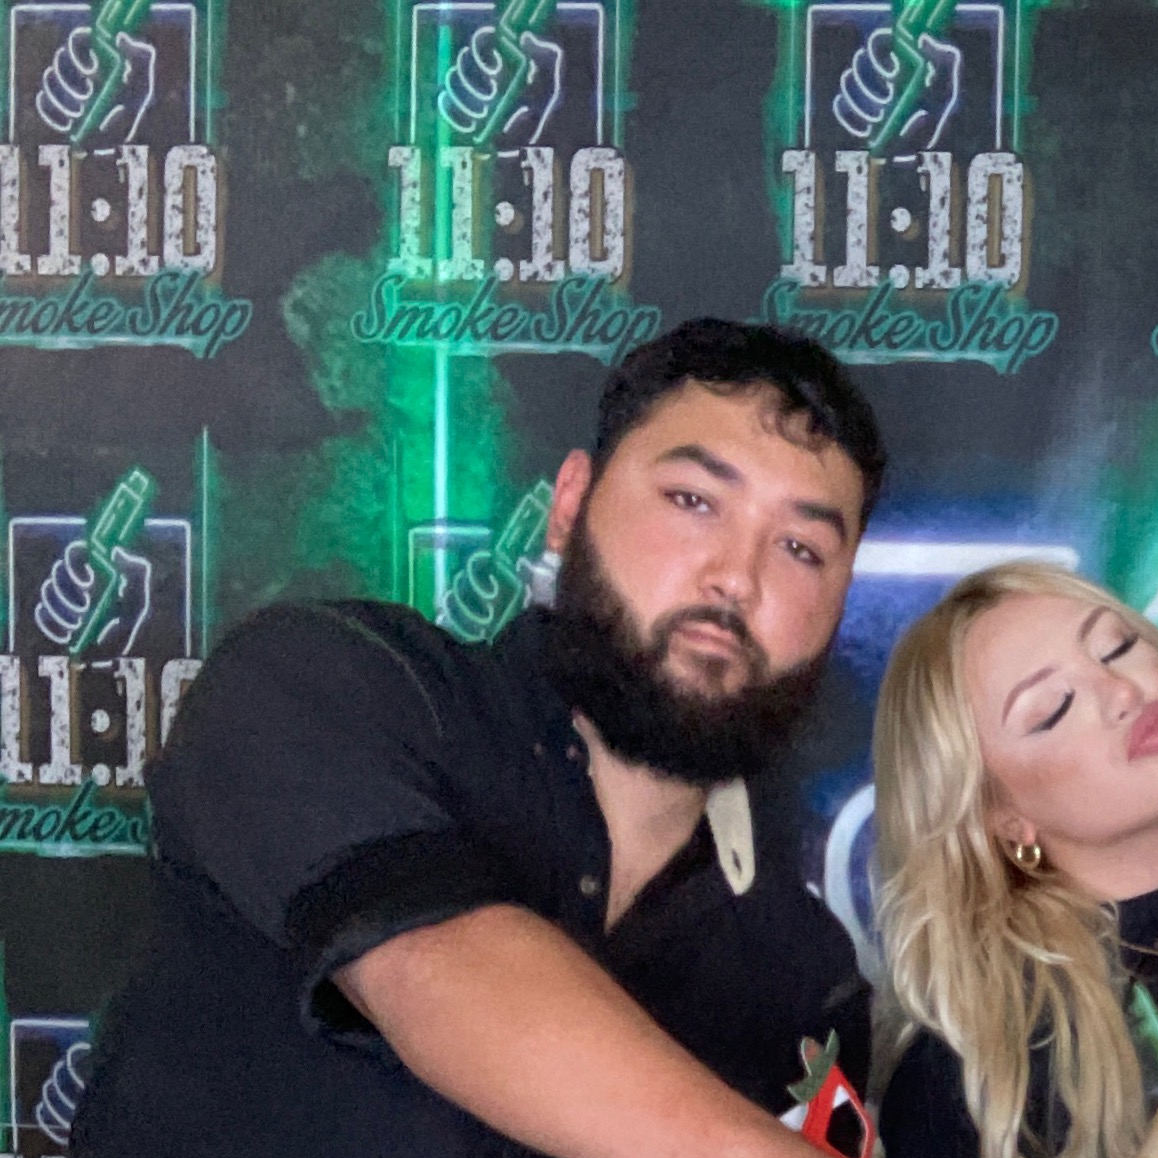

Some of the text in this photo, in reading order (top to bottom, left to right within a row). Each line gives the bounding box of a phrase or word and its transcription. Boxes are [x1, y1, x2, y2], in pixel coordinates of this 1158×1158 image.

[386, 146, 625, 282] 11:10
[780, 151, 1024, 289] 11:10
[0, 268, 252, 359] moke Shop
[351, 271, 662, 367] Smoke Shop
[927, 279, 1060, 374] Shop
[0, 777, 126, 843] moke
